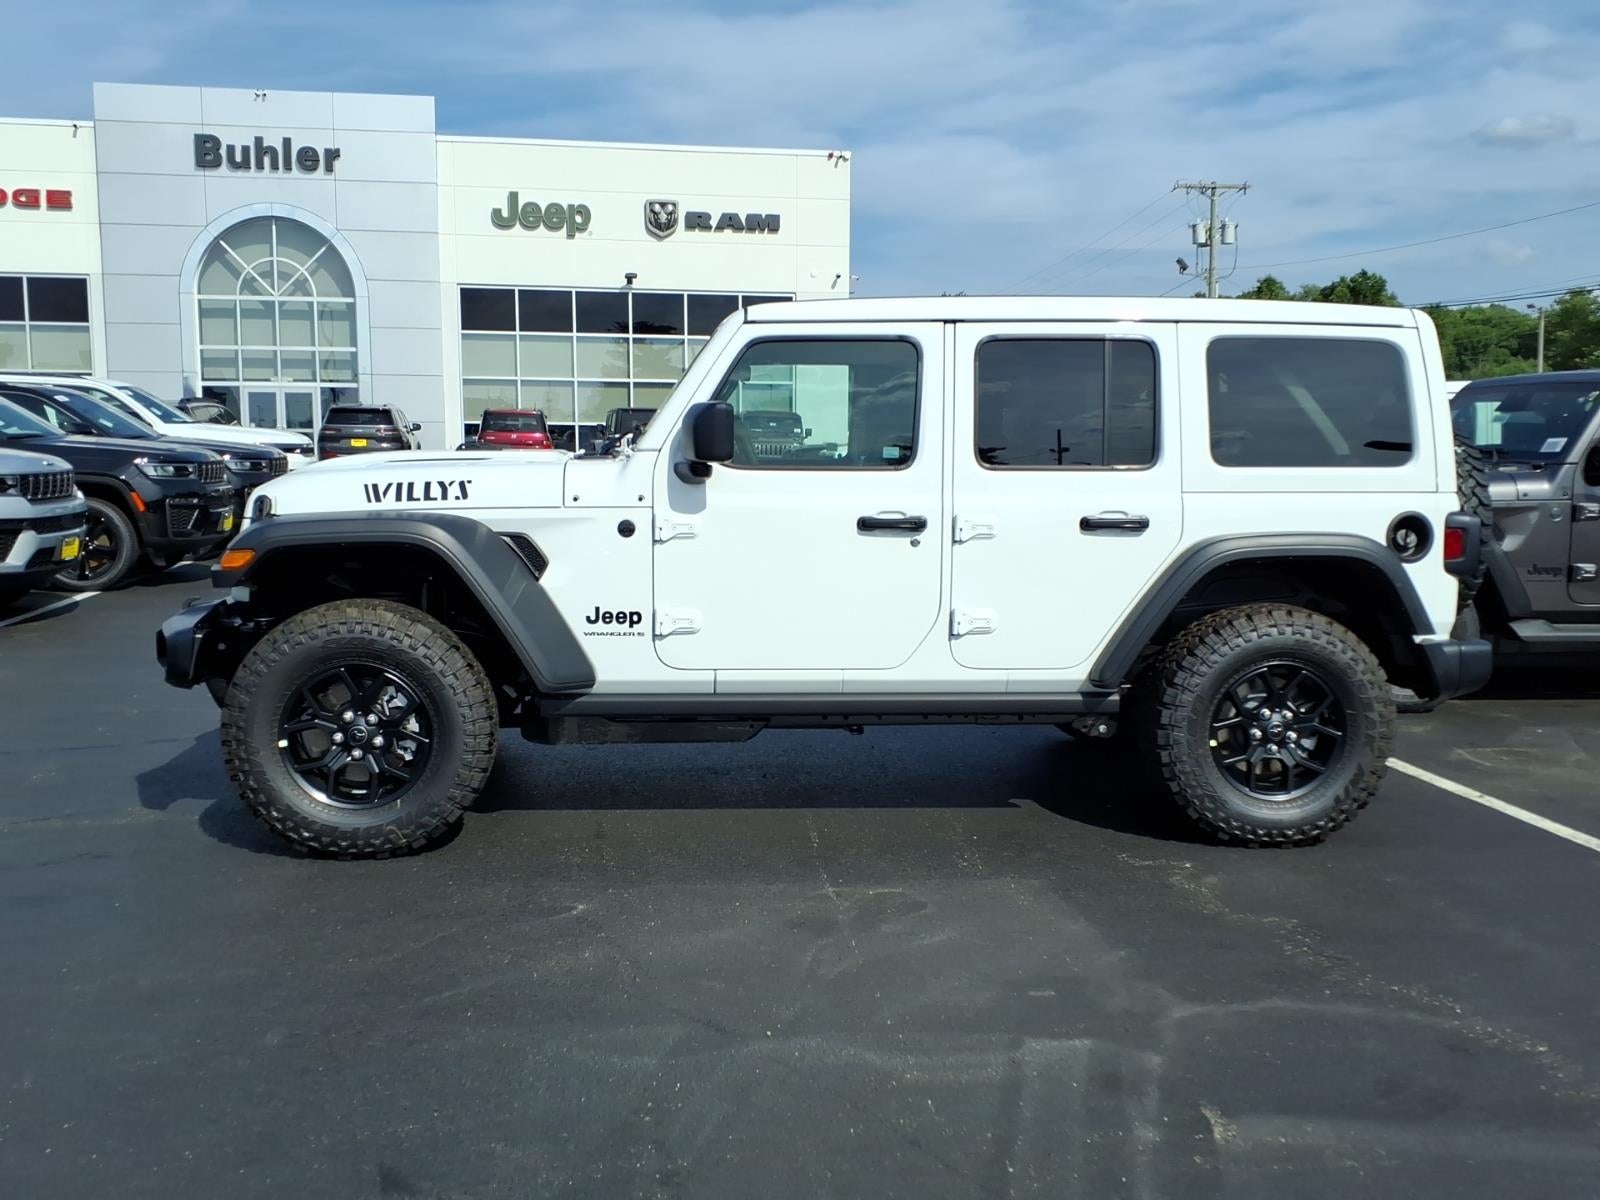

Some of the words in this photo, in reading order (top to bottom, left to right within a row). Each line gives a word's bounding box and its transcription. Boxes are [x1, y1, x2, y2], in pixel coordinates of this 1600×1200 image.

[194, 133, 341, 173] Buhler
[0, 188, 73, 209] GE
[491, 191, 591, 239] Jeep
[684, 211, 781, 233] RAM
[363, 480, 472, 503] WILLYS
[585, 606, 642, 628] Jeep
